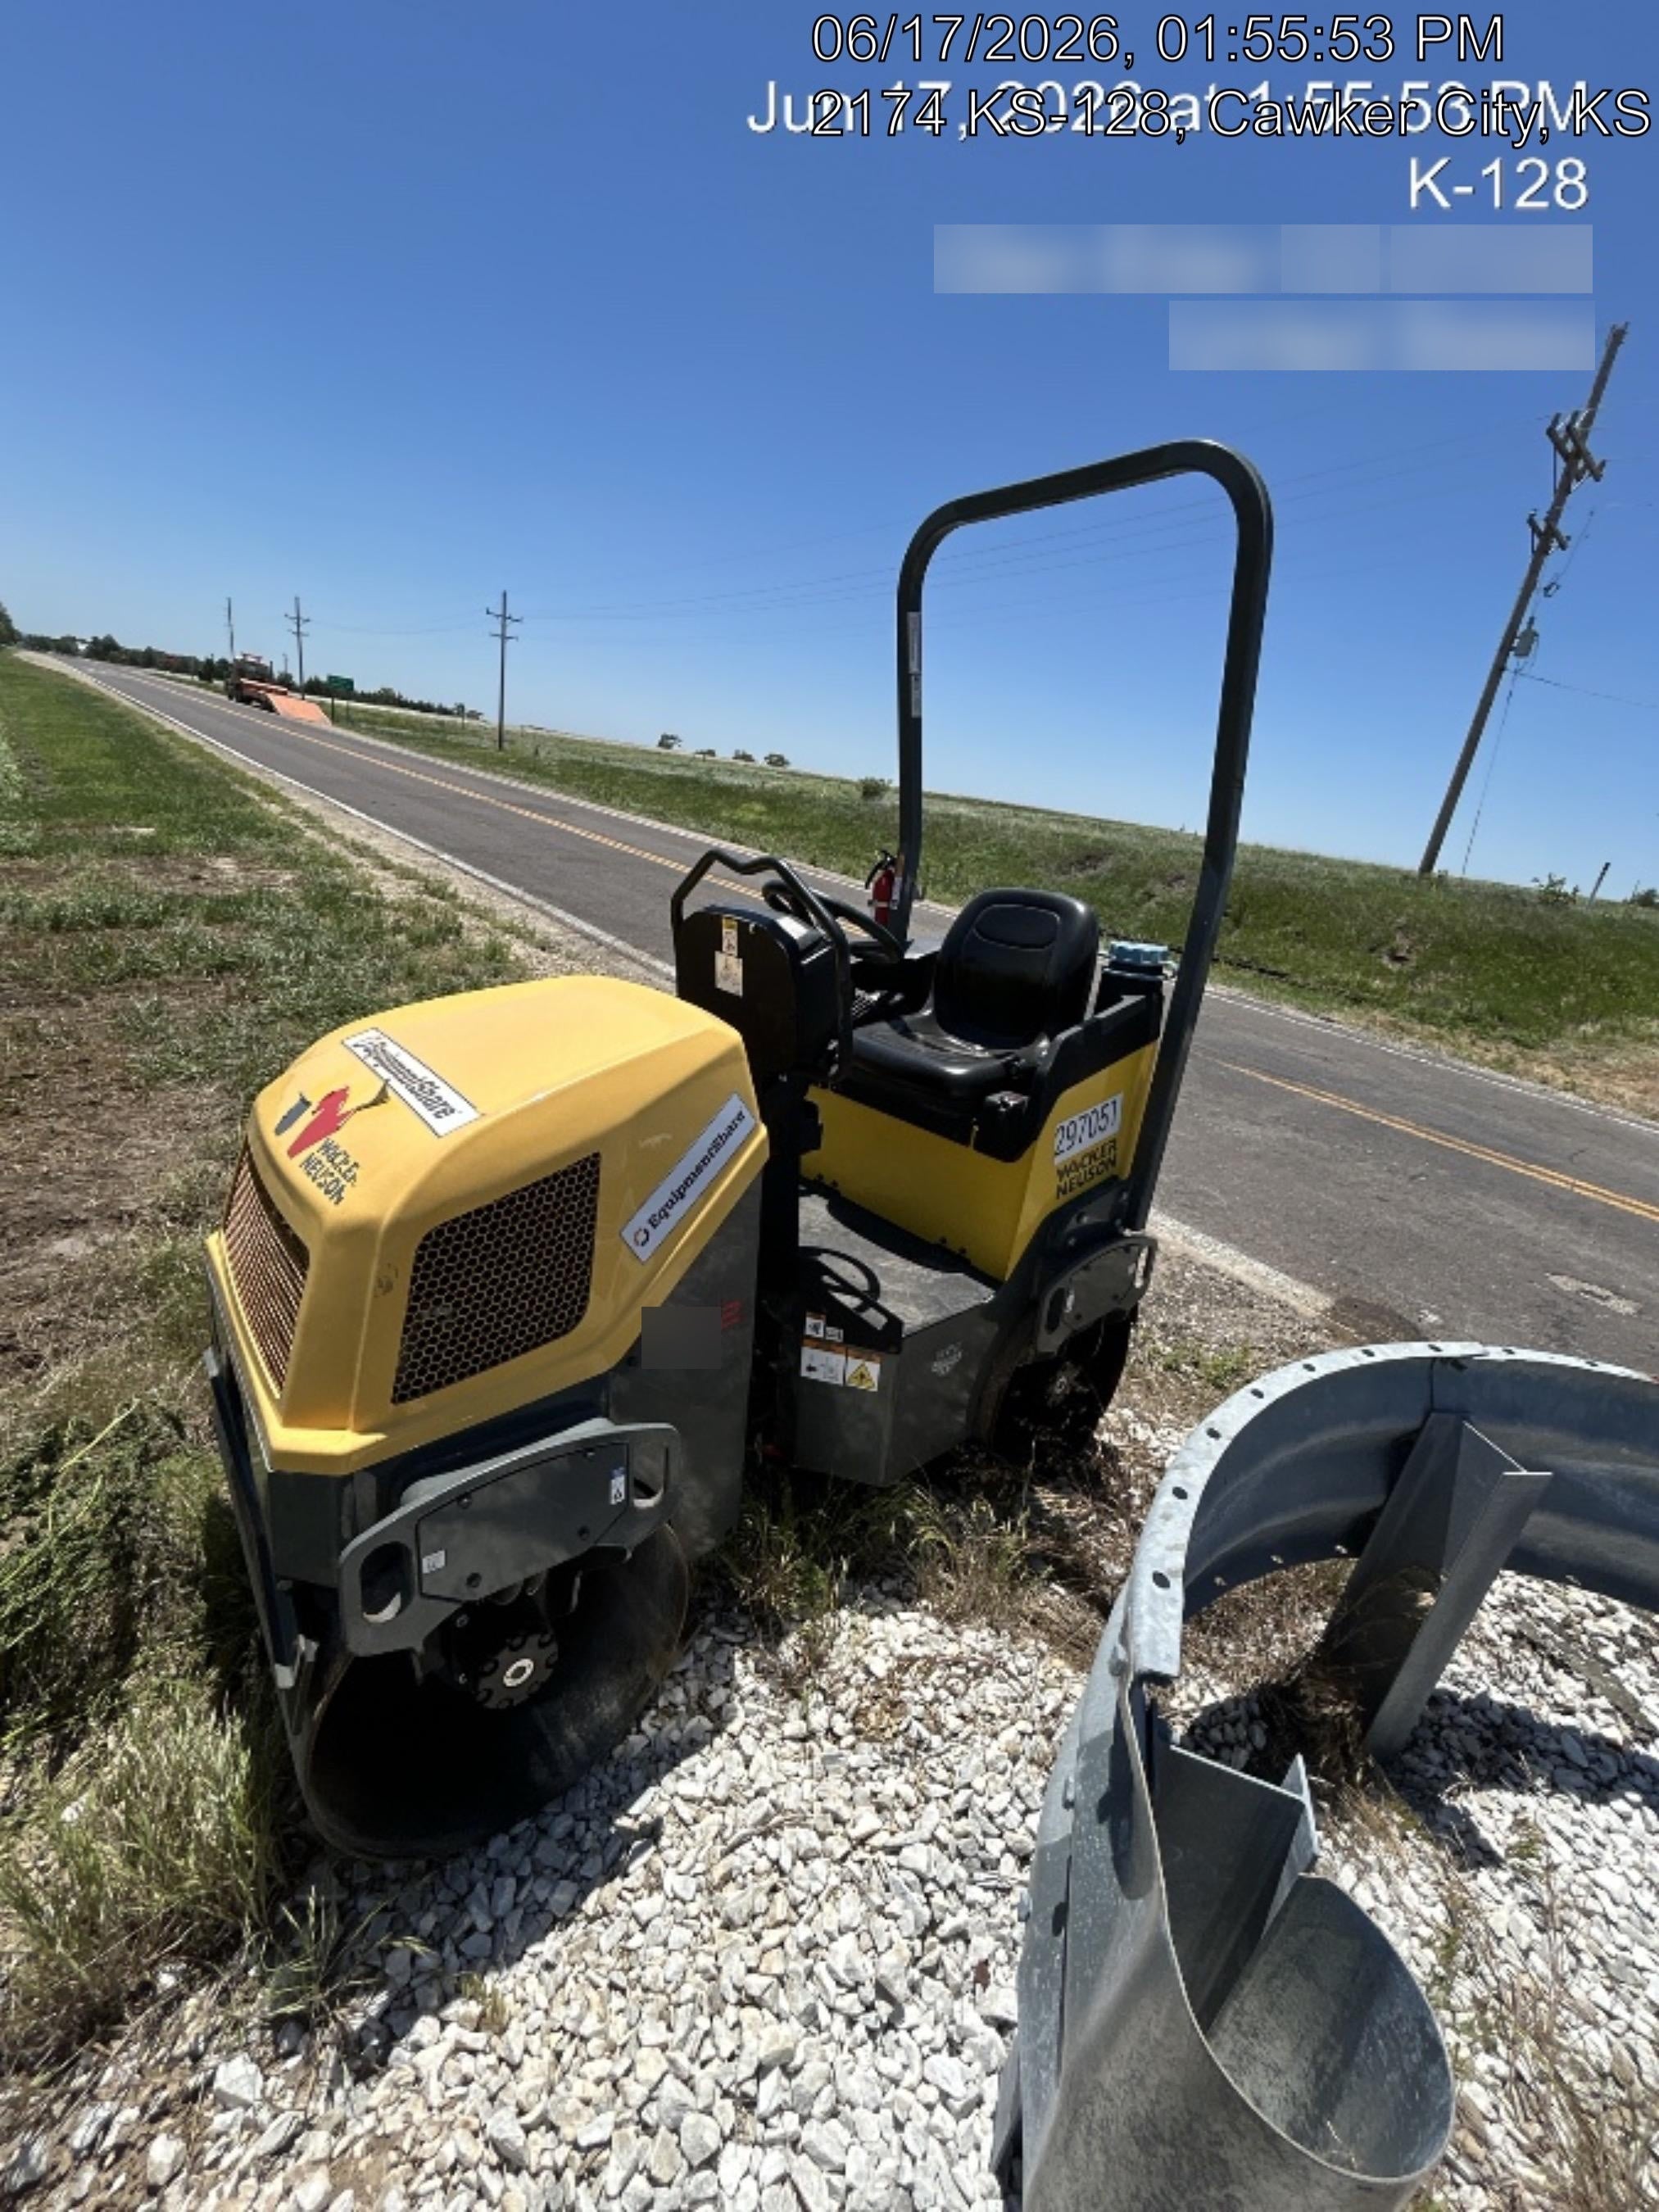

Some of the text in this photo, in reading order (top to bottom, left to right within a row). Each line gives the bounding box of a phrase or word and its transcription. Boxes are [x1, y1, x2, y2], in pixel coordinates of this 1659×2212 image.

[1054, 1099, 1117, 1155] 297051
[648, 1110, 746, 1229] EquipmentShare
[1057, 1139, 1117, 1181] WACKER
[1057, 1157, 1117, 1200] NELSON
